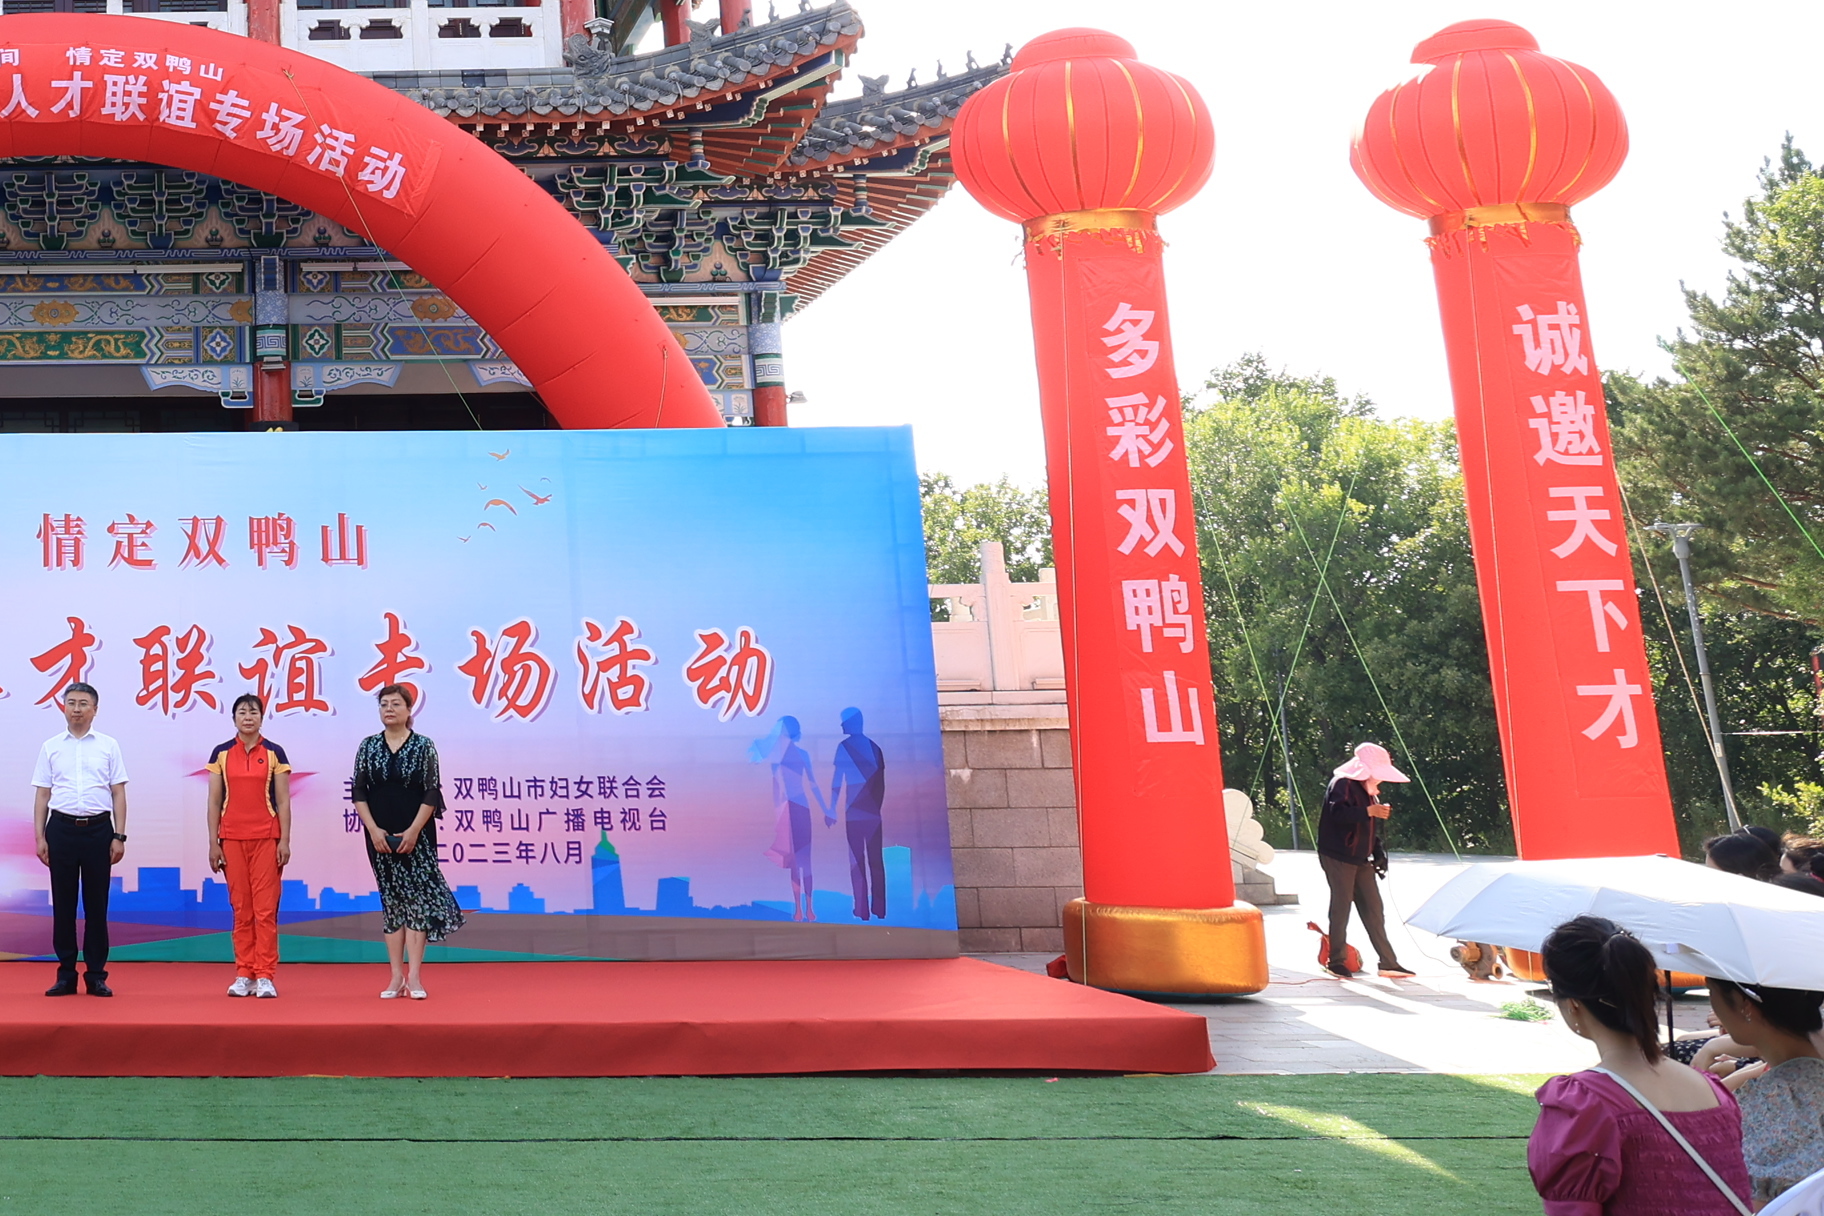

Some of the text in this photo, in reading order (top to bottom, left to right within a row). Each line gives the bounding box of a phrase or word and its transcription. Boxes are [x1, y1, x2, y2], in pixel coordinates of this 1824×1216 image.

[66, 47, 224, 82] 情定双鸭山
[39, 512, 368, 570] 情定双鸭山
[1101, 302, 1207, 746] 多彩双鸭山
[1513, 301, 1644, 750] 诚邀天下才
[453, 775, 666, 801] 双鸭山市妇女联合会
[454, 808, 668, 833] 双鸭山广播电视台
